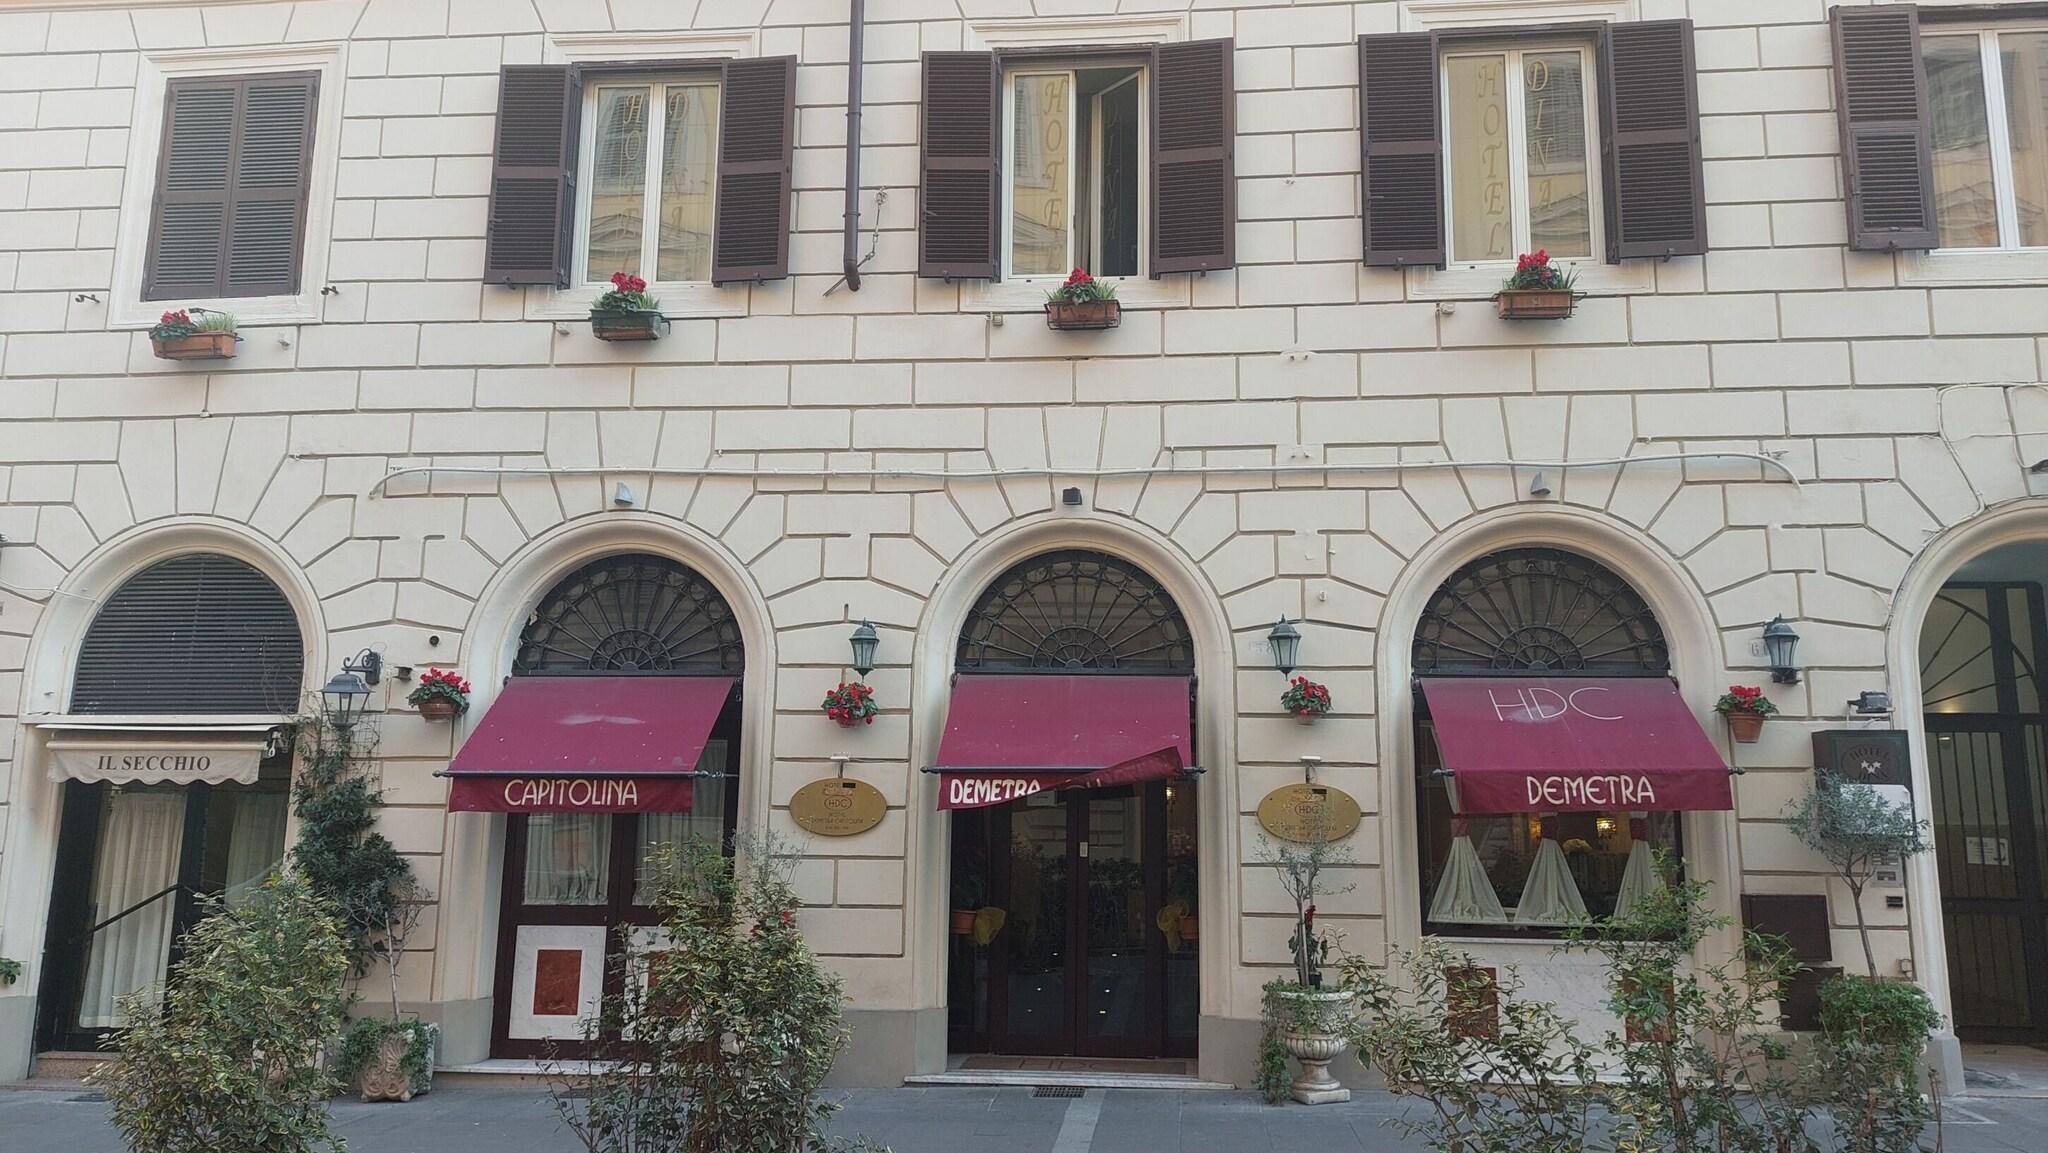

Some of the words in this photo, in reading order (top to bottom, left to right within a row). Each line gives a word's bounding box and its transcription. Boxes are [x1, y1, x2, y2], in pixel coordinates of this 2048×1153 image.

[1527, 60, 1553, 208] DINA
[1488, 687, 1623, 721] HDC
[97, 755, 117, 770] IL
[121, 755, 211, 771] SECCHIO
[504, 779, 637, 806] CAPITOLINA
[950, 778, 1041, 804] DEMETRA
[1526, 775, 1655, 805] DEMETRA
